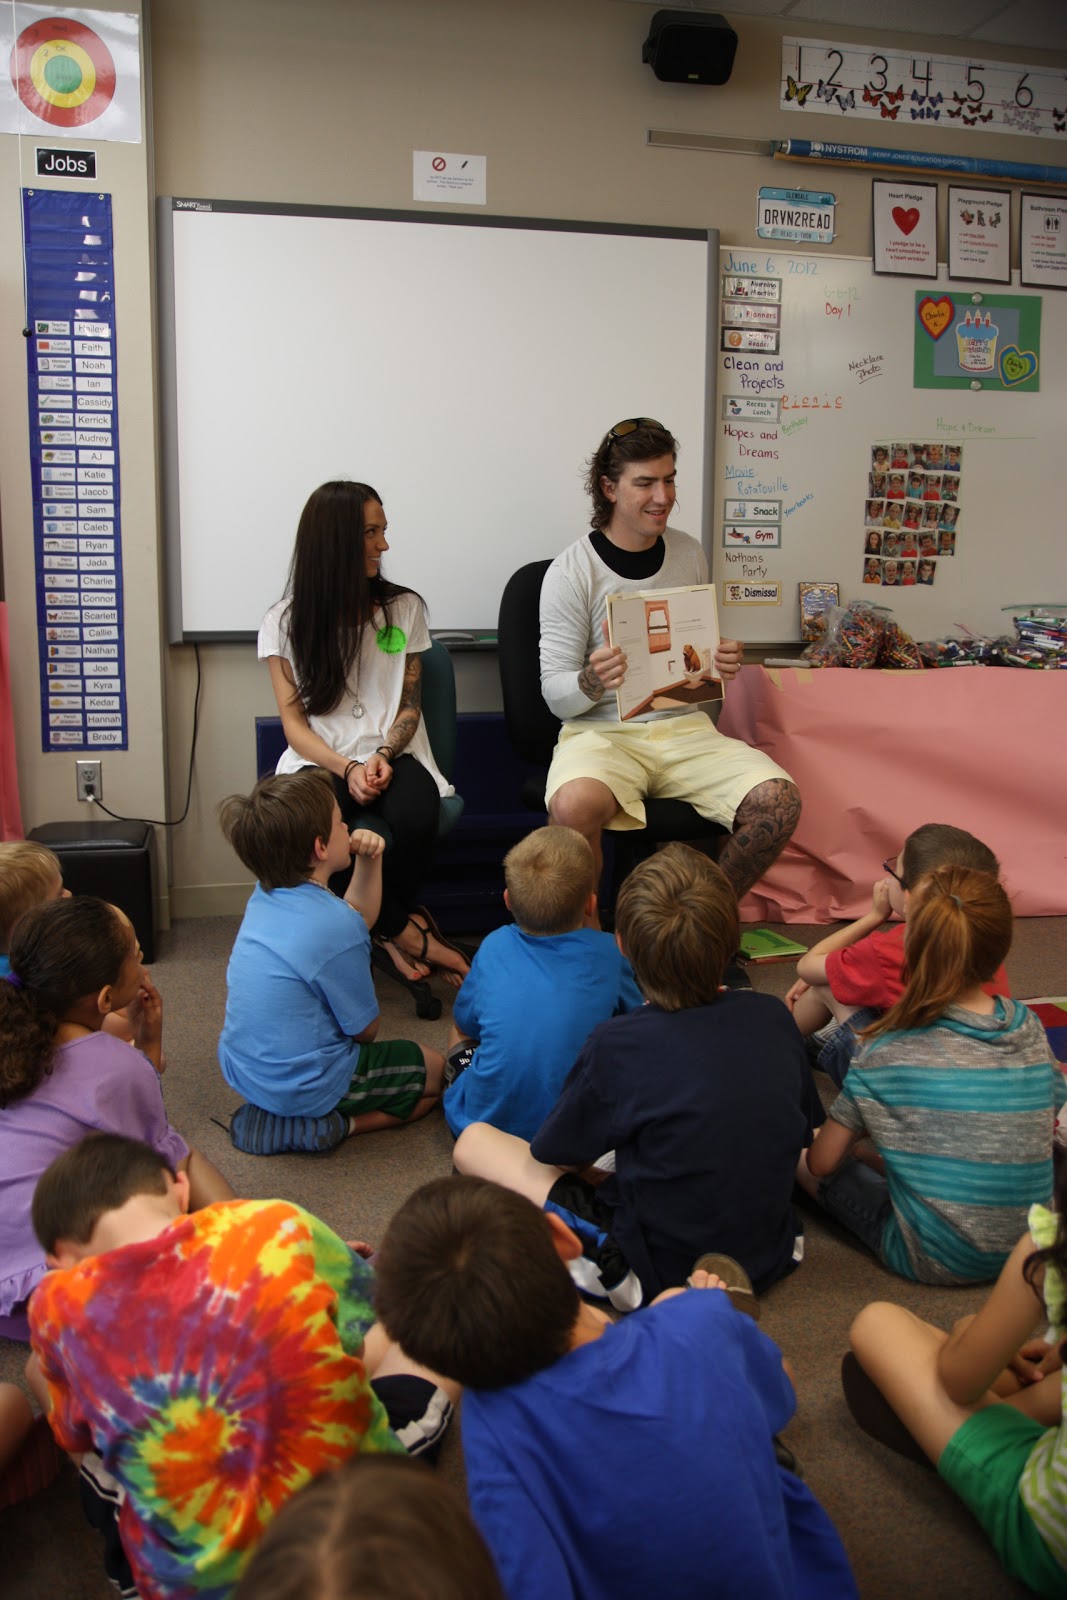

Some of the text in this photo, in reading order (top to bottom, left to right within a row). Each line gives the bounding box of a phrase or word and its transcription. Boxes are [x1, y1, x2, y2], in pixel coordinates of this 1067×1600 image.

[826, 50, 843, 87] 2
[869, 55, 888, 91] 3
[912, 59, 932, 97] 4
[967, 66, 985, 102] 5
[1015, 73, 1033, 108] 6
[825, 144, 868, 157] NYSTROM
[45, 155, 88, 173] Jobs
[786, 192, 808, 200] GLENDALE
[904, 194, 922, 202] Pledge
[176, 200, 196, 208] SMART
[764, 209, 830, 230] DRVN2READ
[724, 253, 757, 274] June
[787, 260, 818, 276] 2012
[746, 310, 776, 320] Planners
[825, 303, 842, 320] Day
[78, 324, 105, 333] Hailey
[82, 344, 103, 352] Faith
[82, 361, 106, 370] Noah
[724, 356, 784, 372] Clean and
[848, 354, 884, 372] Necklace
[87, 380, 101, 388] Ian
[740, 374, 784, 394] Projects
[78, 398, 112, 408] Cassidy
[78, 416, 108, 424] Kerrick
[724, 424, 778, 442] Hopes and
[78, 434, 109, 444] Audrey
[91, 452, 102, 460] AJ
[738, 444, 779, 460] Dreams
[84, 470, 106, 478] Katie
[737, 476, 788, 496] Ratatouille
[82, 488, 108, 496] Jacob
[86, 506, 106, 514] Sam
[753, 506, 778, 516] Snack
[83, 522, 108, 531] Caleb
[754, 530, 774, 542] Gym
[86, 541, 108, 550] Ryan
[86, 558, 108, 566] Jada
[725, 552, 764, 564] Nathan's
[742, 564, 768, 578] Party
[83, 576, 113, 585] Charlie
[82, 594, 114, 602] Connor
[84, 612, 116, 620] Scarlett
[88, 628, 112, 637] Callie
[85, 646, 116, 654] Nathan
[92, 664, 108, 672] Joe
[93, 682, 112, 690] Kyra
[92, 732, 116, 742] Brady
